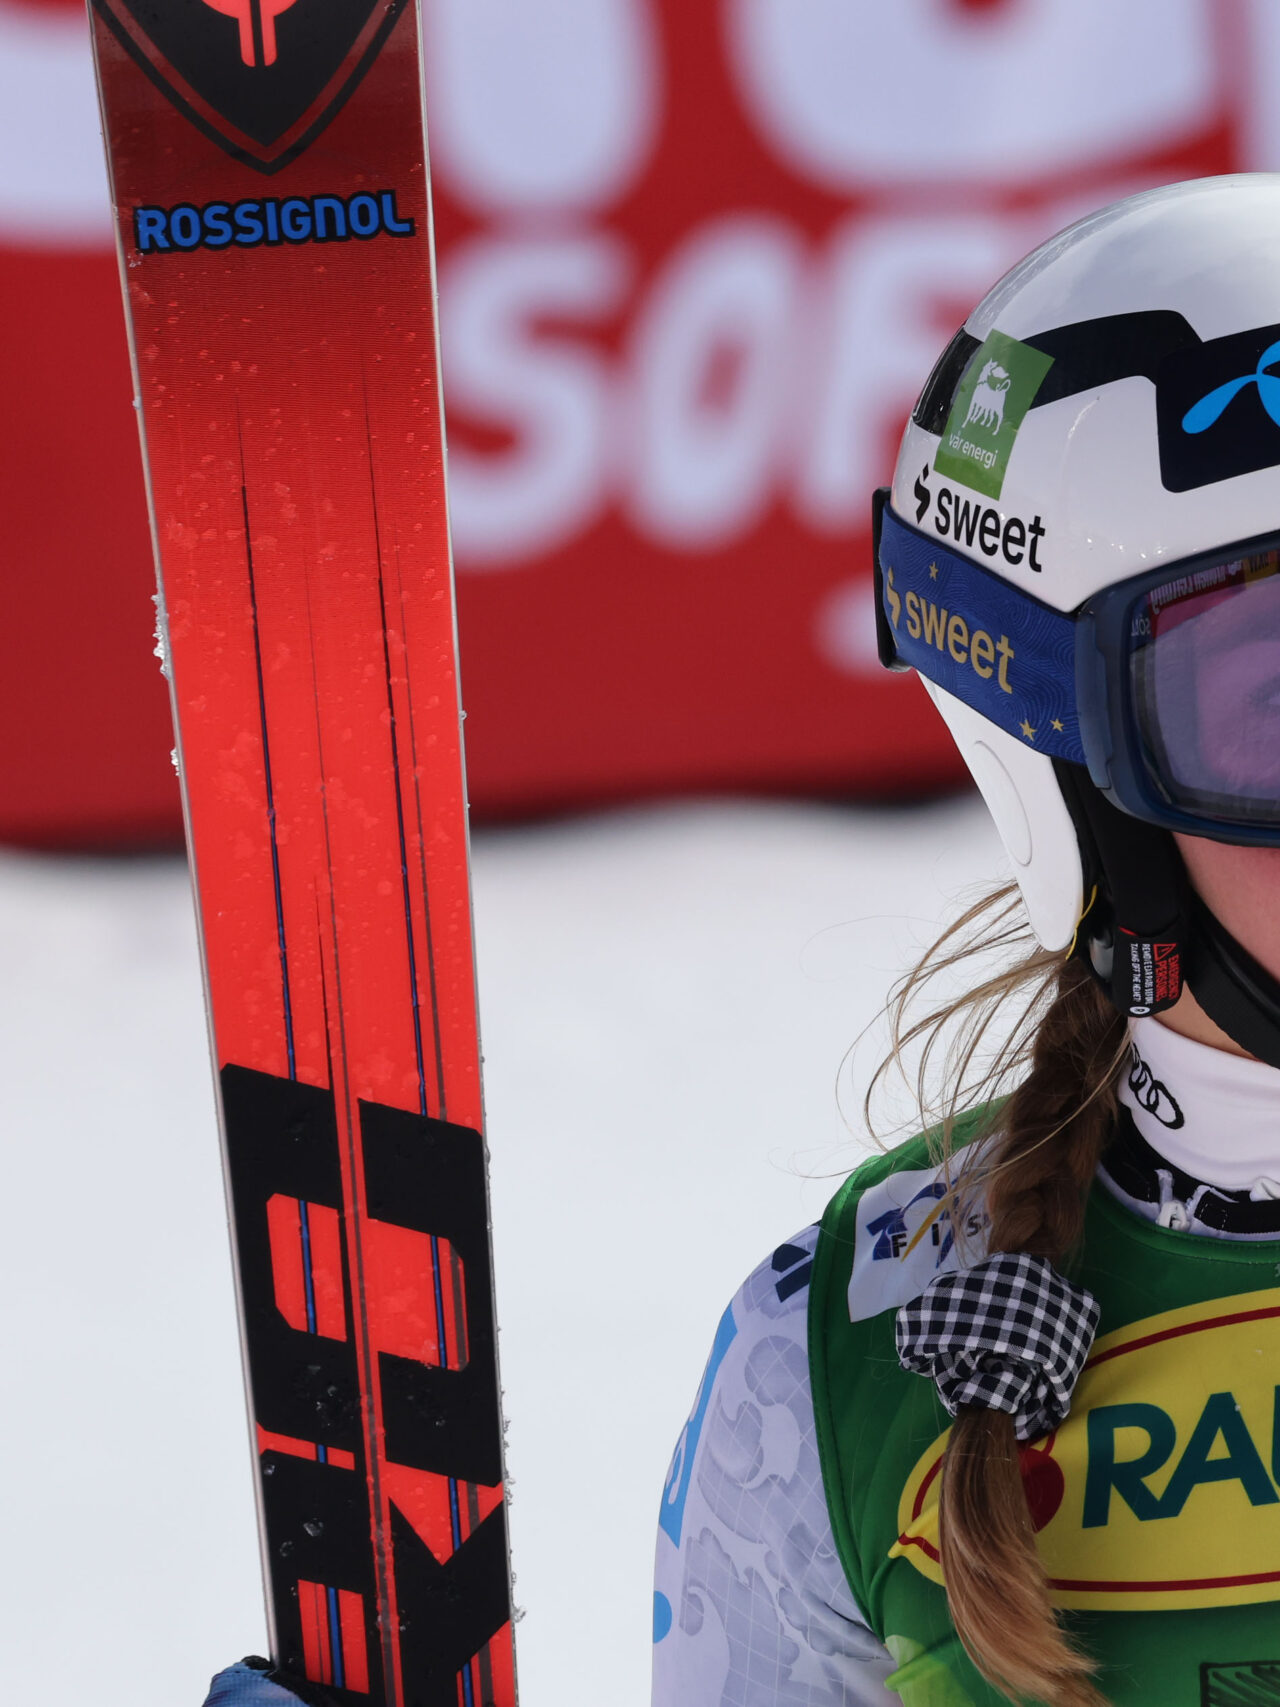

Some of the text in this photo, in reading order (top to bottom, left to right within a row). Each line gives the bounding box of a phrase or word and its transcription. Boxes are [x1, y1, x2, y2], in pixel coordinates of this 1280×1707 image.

[136, 192, 412, 250] ROSSIGNOL
[435, 210, 1080, 570] SOF
[962, 441, 999, 469] energi
[934, 487, 1046, 573] sweet
[905, 590, 1015, 694] sweet
